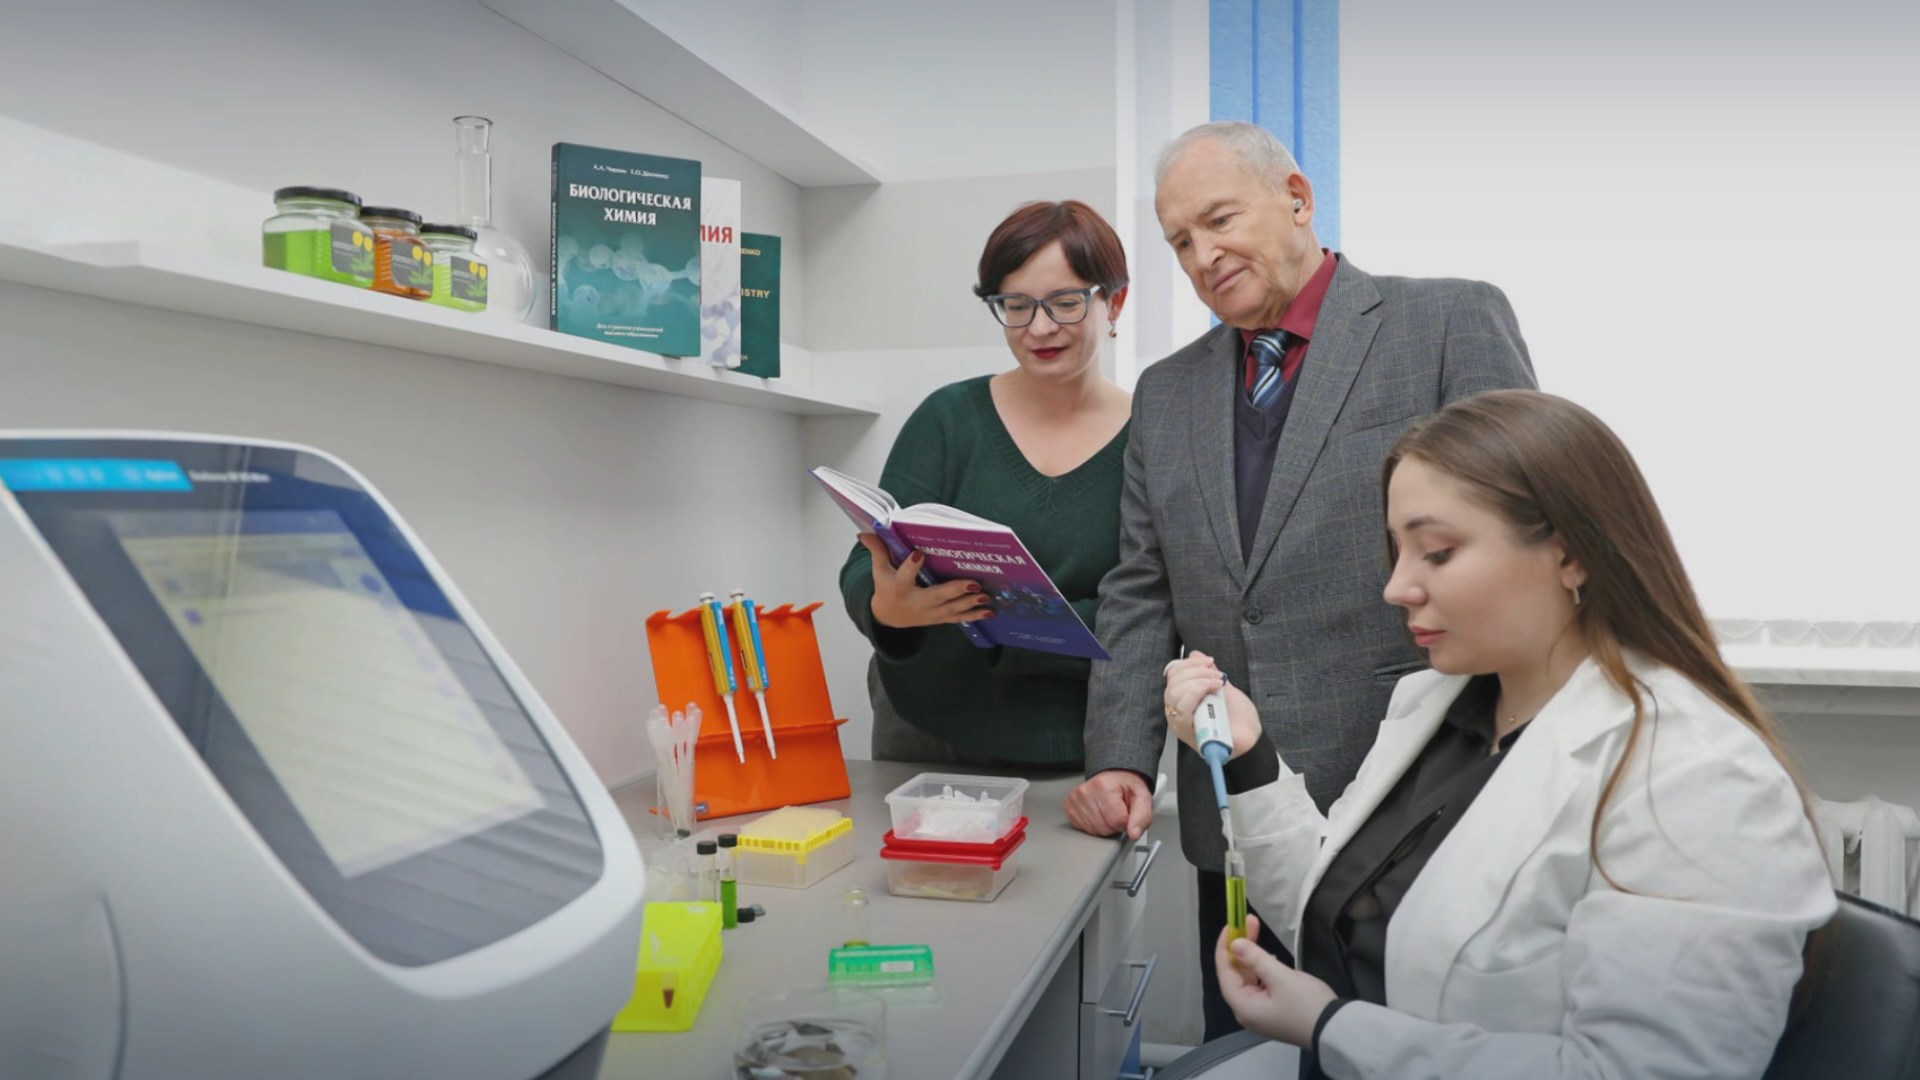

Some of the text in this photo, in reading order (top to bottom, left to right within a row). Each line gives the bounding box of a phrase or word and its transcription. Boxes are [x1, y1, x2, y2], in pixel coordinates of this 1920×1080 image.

[569, 183, 692, 211] БИОЛОГИЧЕСКАЯ
[604, 207, 657, 226] ХИМИЯ
[953, 560, 1004, 575] ХИМИЯ
